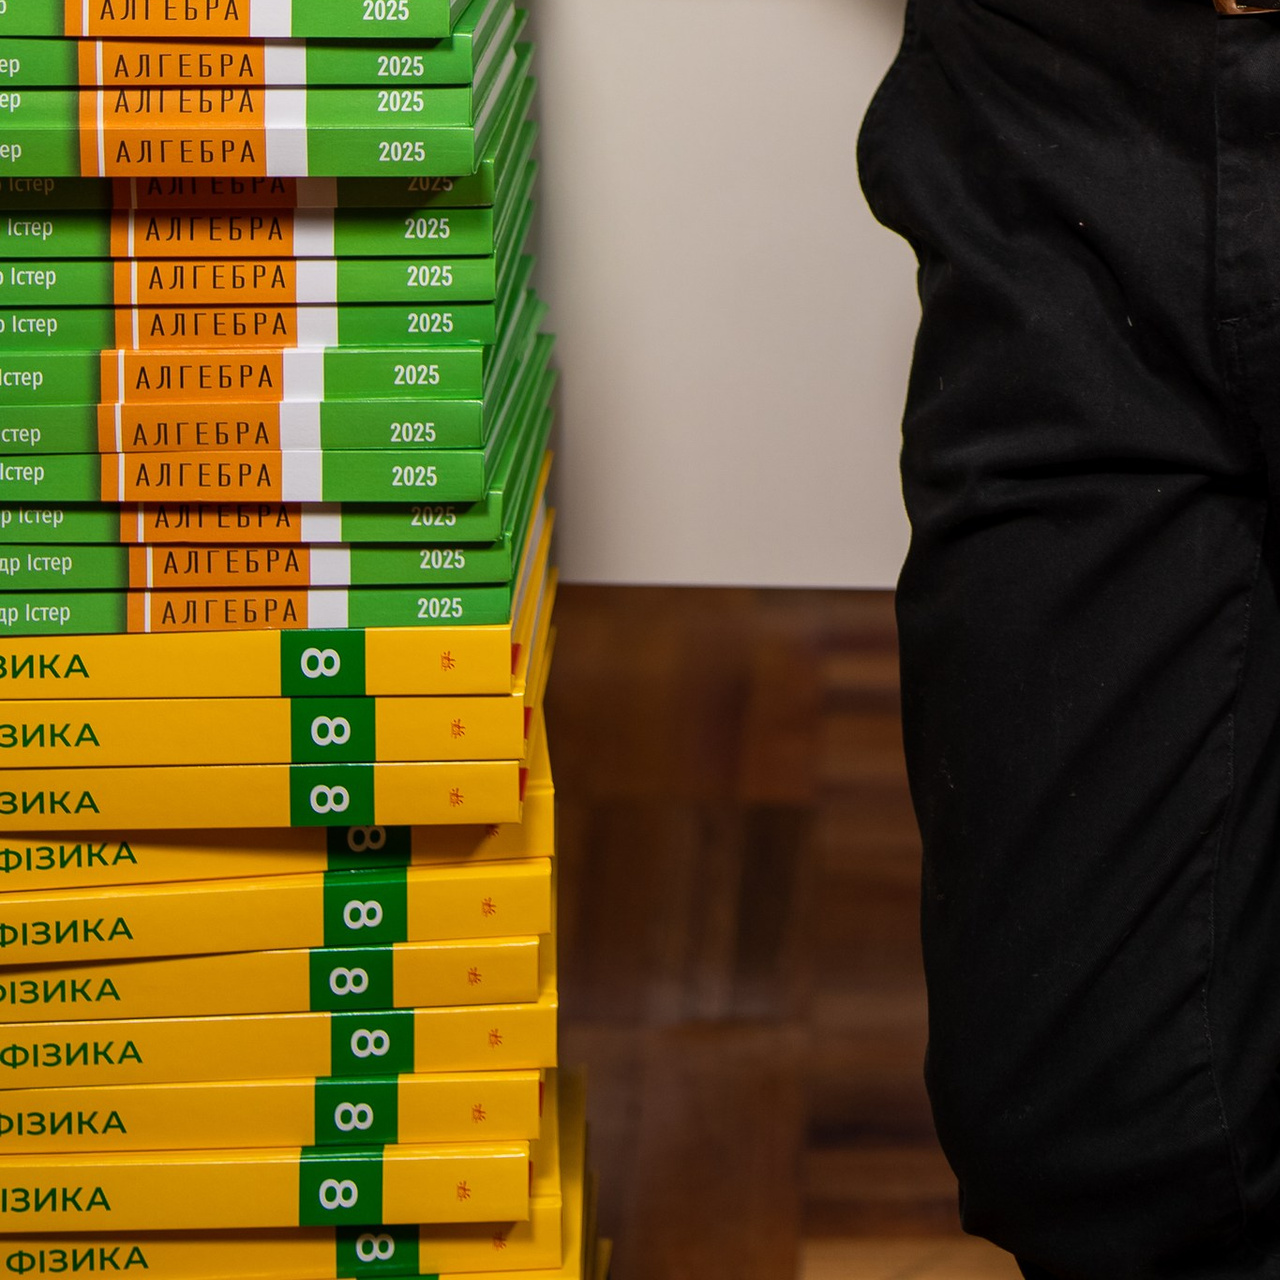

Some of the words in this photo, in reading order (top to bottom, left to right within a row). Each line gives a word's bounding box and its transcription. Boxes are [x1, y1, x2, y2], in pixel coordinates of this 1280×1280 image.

[363, 0, 409, 20] 2025
[115, 54, 253, 77] АЛГЕБРА
[378, 56, 423, 75] 2025
[114, 88, 254, 114] АЛГЕБРА
[378, 91, 423, 111] 2025
[117, 140, 254, 162] АЛГЕБРА
[379, 142, 425, 161] 2025
[7, 219, 53, 240] Істер
[145, 217, 283, 241] АЛГЕБРА
[405, 219, 449, 238] 2025
[12, 268, 56, 289] Істер
[149, 265, 285, 289] АЛГЕБРА
[408, 266, 452, 286] 2025
[13, 316, 57, 336] Істер
[151, 313, 286, 336] АЛГЕБРА
[408, 313, 453, 332] 2025
[136, 365, 272, 389] АЛГЕБРА
[395, 365, 439, 384] 2025
[133, 422, 269, 445] АЛГЕБРА
[391, 423, 435, 441] 2025
[136, 464, 270, 486] АЛГЕБРА
[393, 466, 437, 486] 2025
[155, 504, 290, 528] АЛГЕБРА
[411, 506, 456, 527] 2025
[28, 554, 72, 575] Істер
[163, 549, 299, 575] АЛГЕБРА
[420, 551, 465, 568] 2025
[27, 604, 70, 625] Істер
[162, 599, 296, 624] АЛГЕБРА
[418, 598, 462, 617] 2025
[0, 1041, 142, 1069] ФІЗИКА
[6, 1247, 148, 1274] ФІЗИКА
